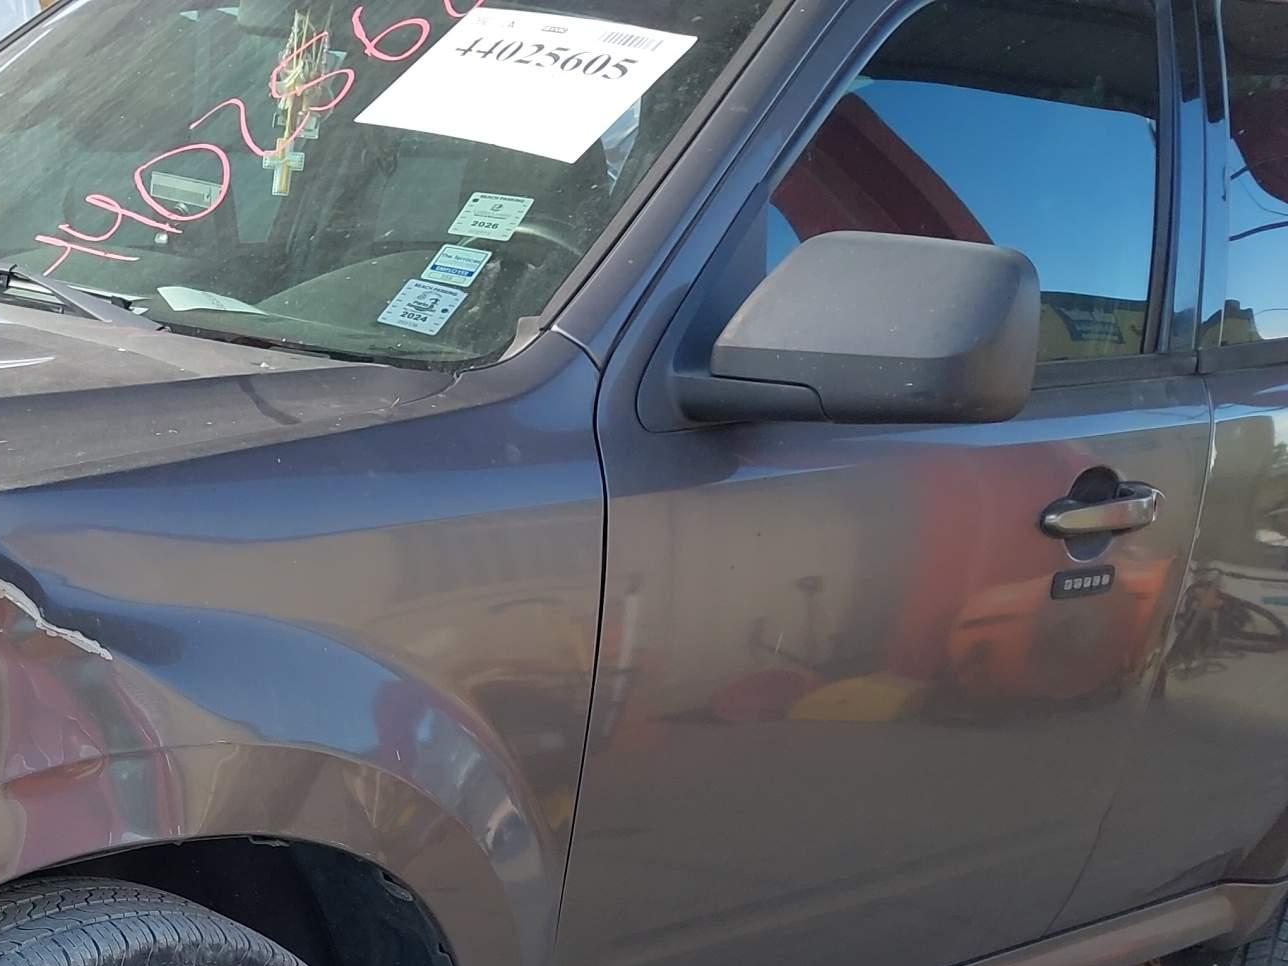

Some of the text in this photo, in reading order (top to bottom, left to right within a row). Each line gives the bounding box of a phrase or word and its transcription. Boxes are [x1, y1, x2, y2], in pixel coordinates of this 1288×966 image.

[455, 36, 638, 80] 44025605
[470, 220, 499, 230] 2026
[400, 311, 429, 322] 2024
